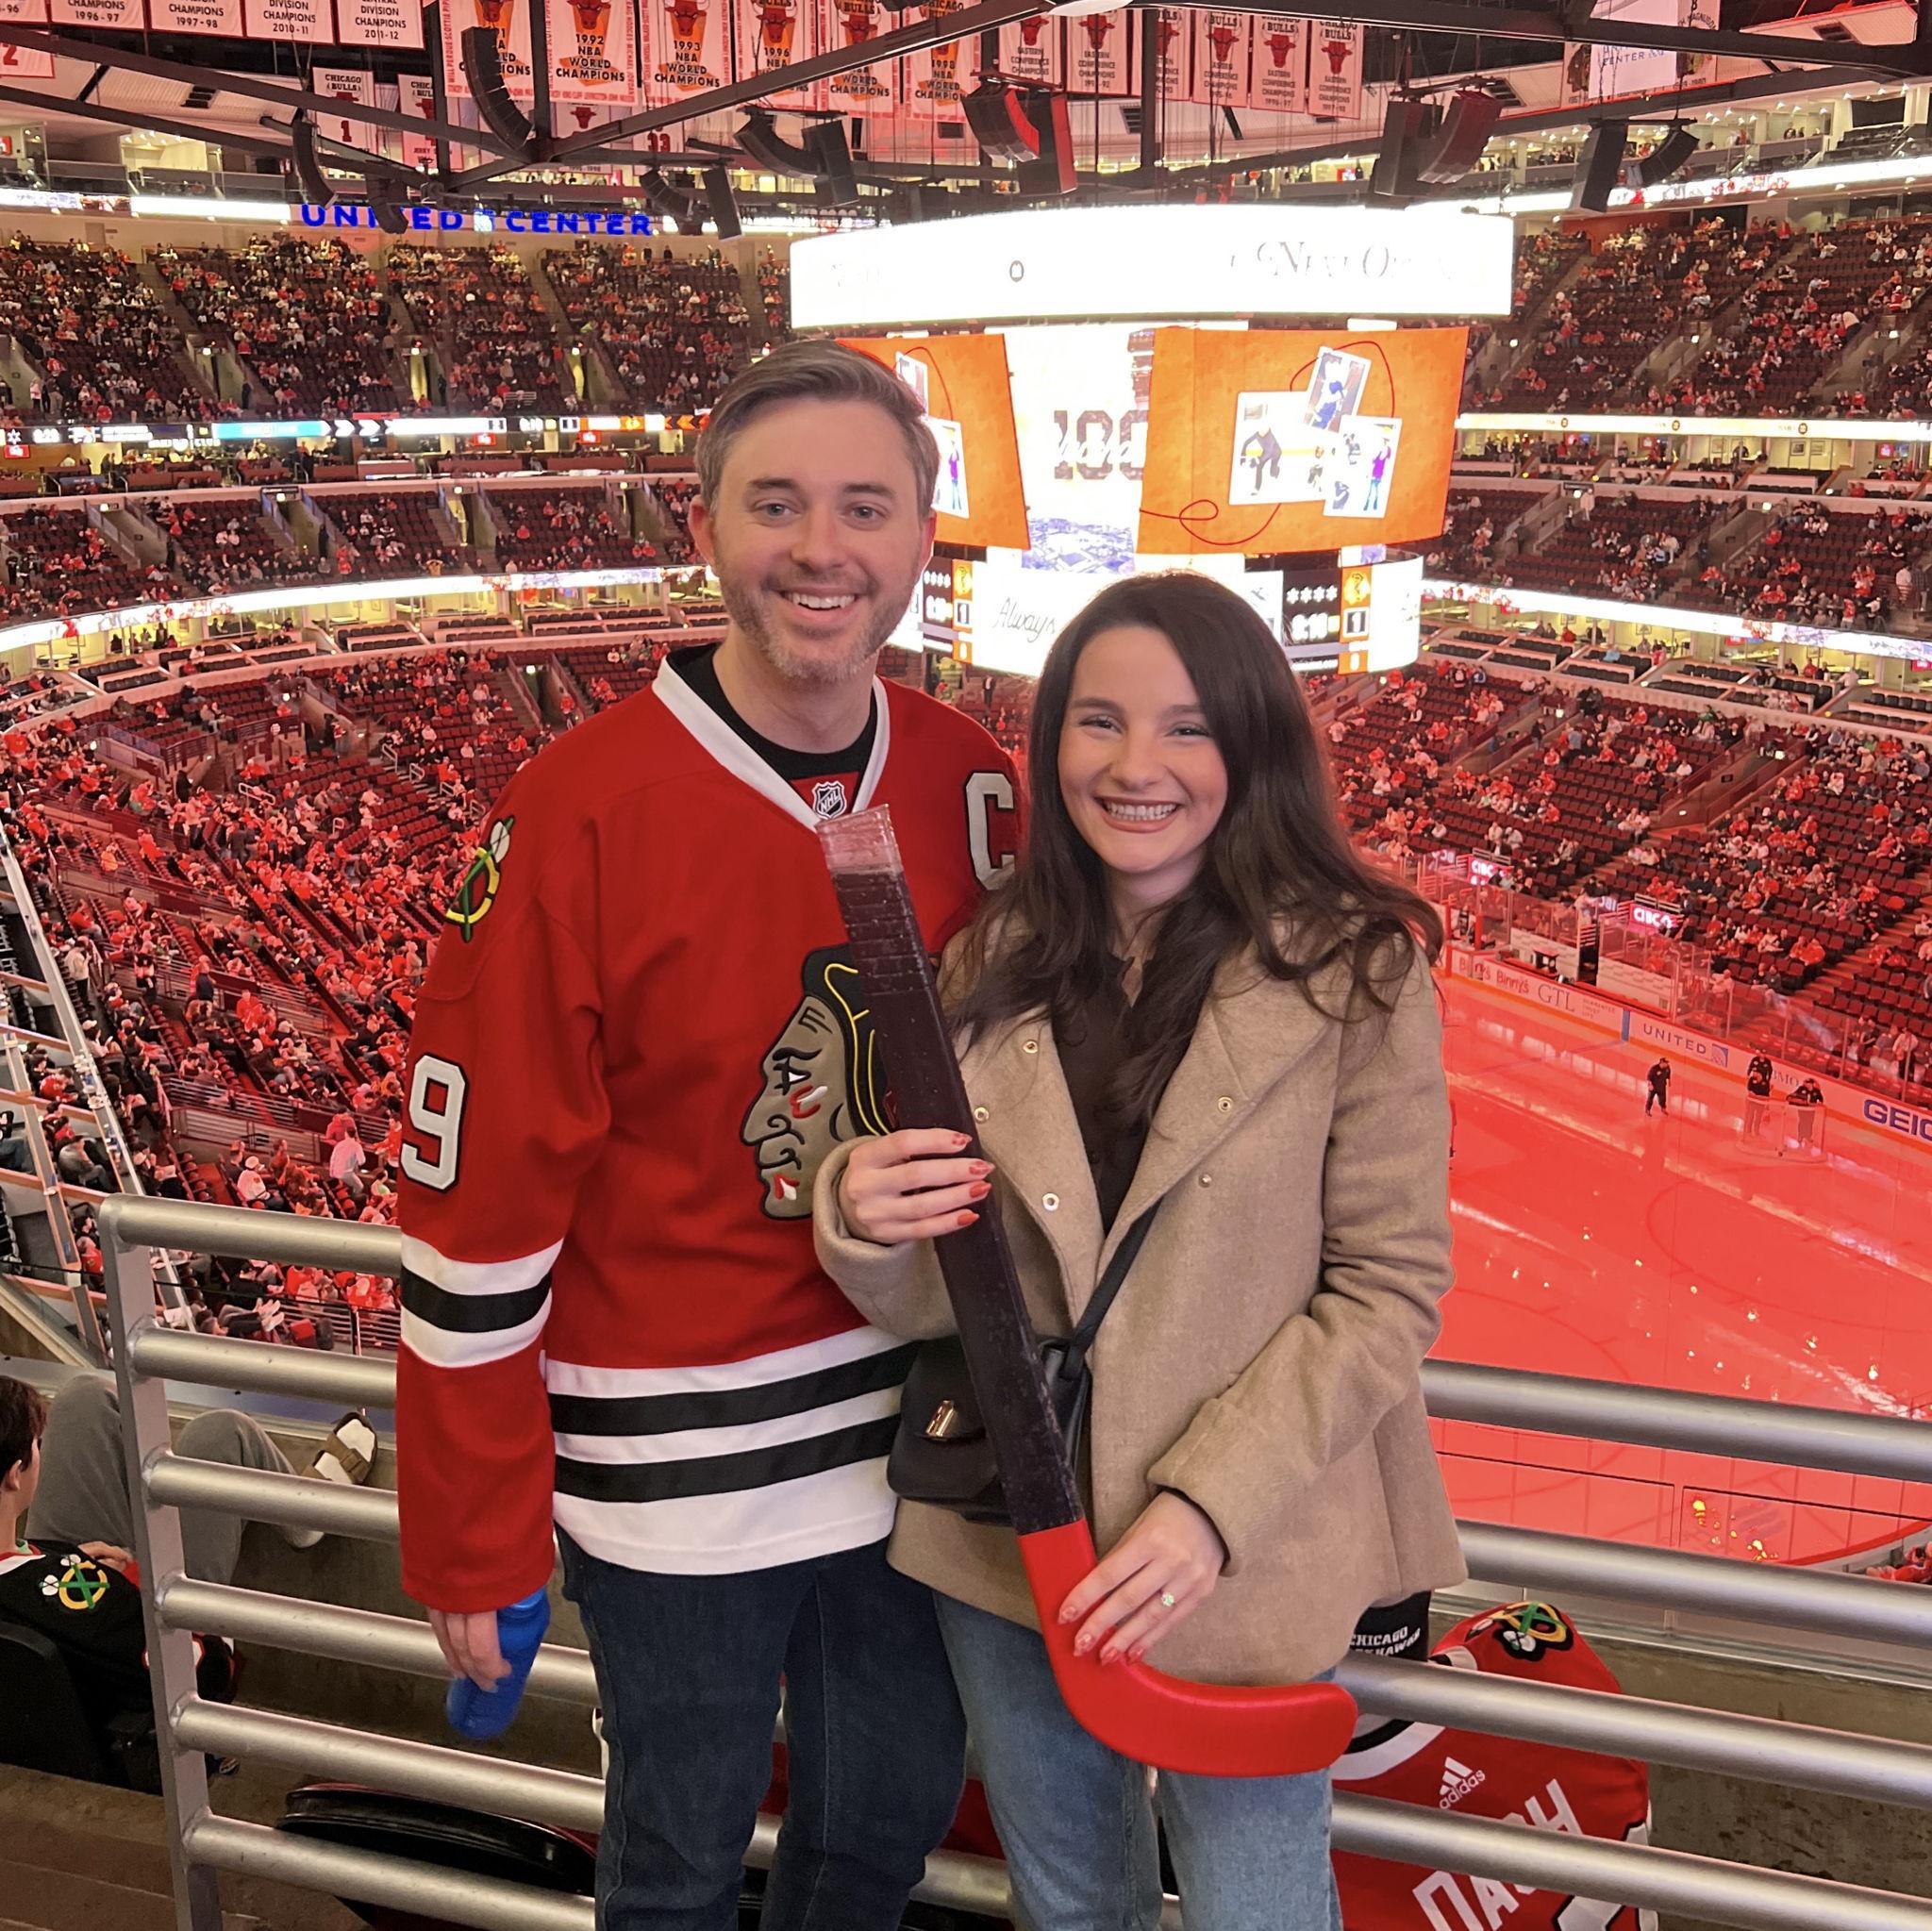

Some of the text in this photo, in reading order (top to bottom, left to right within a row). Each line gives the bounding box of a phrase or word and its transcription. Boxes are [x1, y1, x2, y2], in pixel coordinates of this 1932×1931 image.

[168, 4, 225, 16] CHAMPIONS
[269, 0, 309, 10] DIVISION
[360, 5, 399, 16] DIVISION
[843, 2, 875, 14] BULLS
[176, 16, 218, 28] 1997-98
[263, 10, 316, 24] CHAMPIONS
[355, 17, 407, 28] CHAMPIONS
[1208, 14, 1237, 26] BULLS
[1267, 22, 1295, 33] BULLS
[575, 34, 604, 45] 1992
[1324, 29, 1352, 40] BULLS
[577, 45, 601, 56] NBA
[674, 40, 701, 52] 1993
[764, 47, 791, 57] 1996
[569, 57, 611, 69] WORLD
[675, 52, 698, 62] NBA
[767, 58, 788, 68] NBA
[666, 63, 708, 75] WORLD
[931, 59, 956, 69] 1998
[325, 74, 361, 84] CHICAGO
[556, 68, 625, 82] CHAMPIONS
[654, 73, 720, 88] CHAMPIONS
[841, 75, 877, 86] WORLD
[934, 70, 953, 79] NBA
[331, 82, 357, 92] BULLS
[830, 84, 890, 97] CHAMPIONS
[925, 80, 960, 91] WORLD
[505, 210, 654, 236] CENTER
[820, 789, 841, 812] NHL
[964, 772, 1015, 891] C
[1472, 859, 1495, 878] CIBC
[1633, 907, 1660, 927] CIBC
[1496, 970, 1530, 994] Binny's
[1538, 983, 1574, 1012] GTL
[1643, 1023, 1707, 1055] UNITED
[1350, 1625, 1408, 1646] CHICAGO
[1439, 1770, 1486, 1809] adidas
